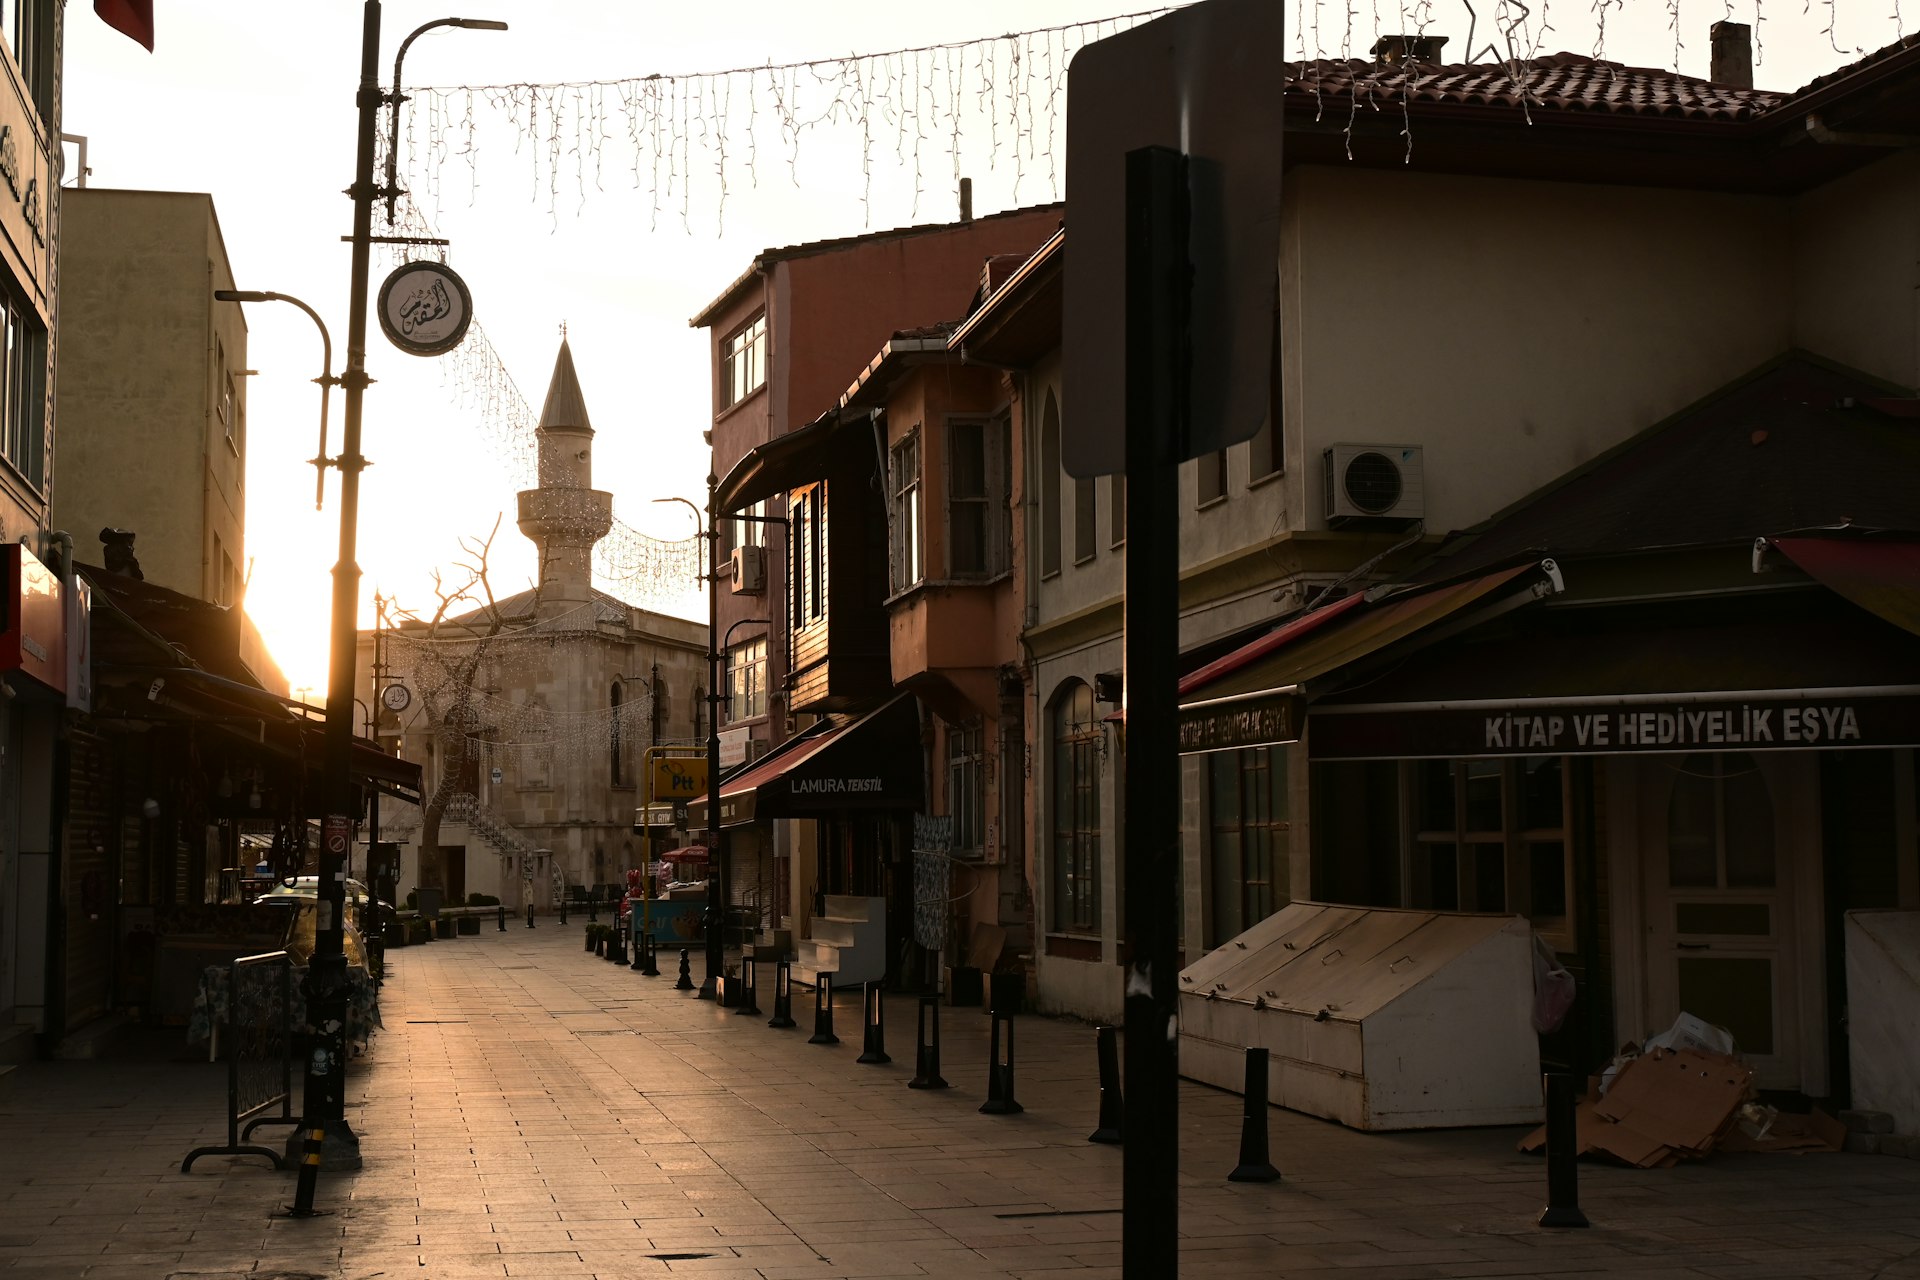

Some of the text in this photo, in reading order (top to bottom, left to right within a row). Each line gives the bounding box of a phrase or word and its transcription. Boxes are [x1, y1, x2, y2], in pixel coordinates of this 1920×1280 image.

[1179, 716, 1203, 747] KİTAP
[1485, 705, 1861, 748] KİTAP VE HEDİYELİK EŞYA
[672, 775, 695, 791] Ptt
[791, 776, 883, 794] LAMURA TEKSTİL
